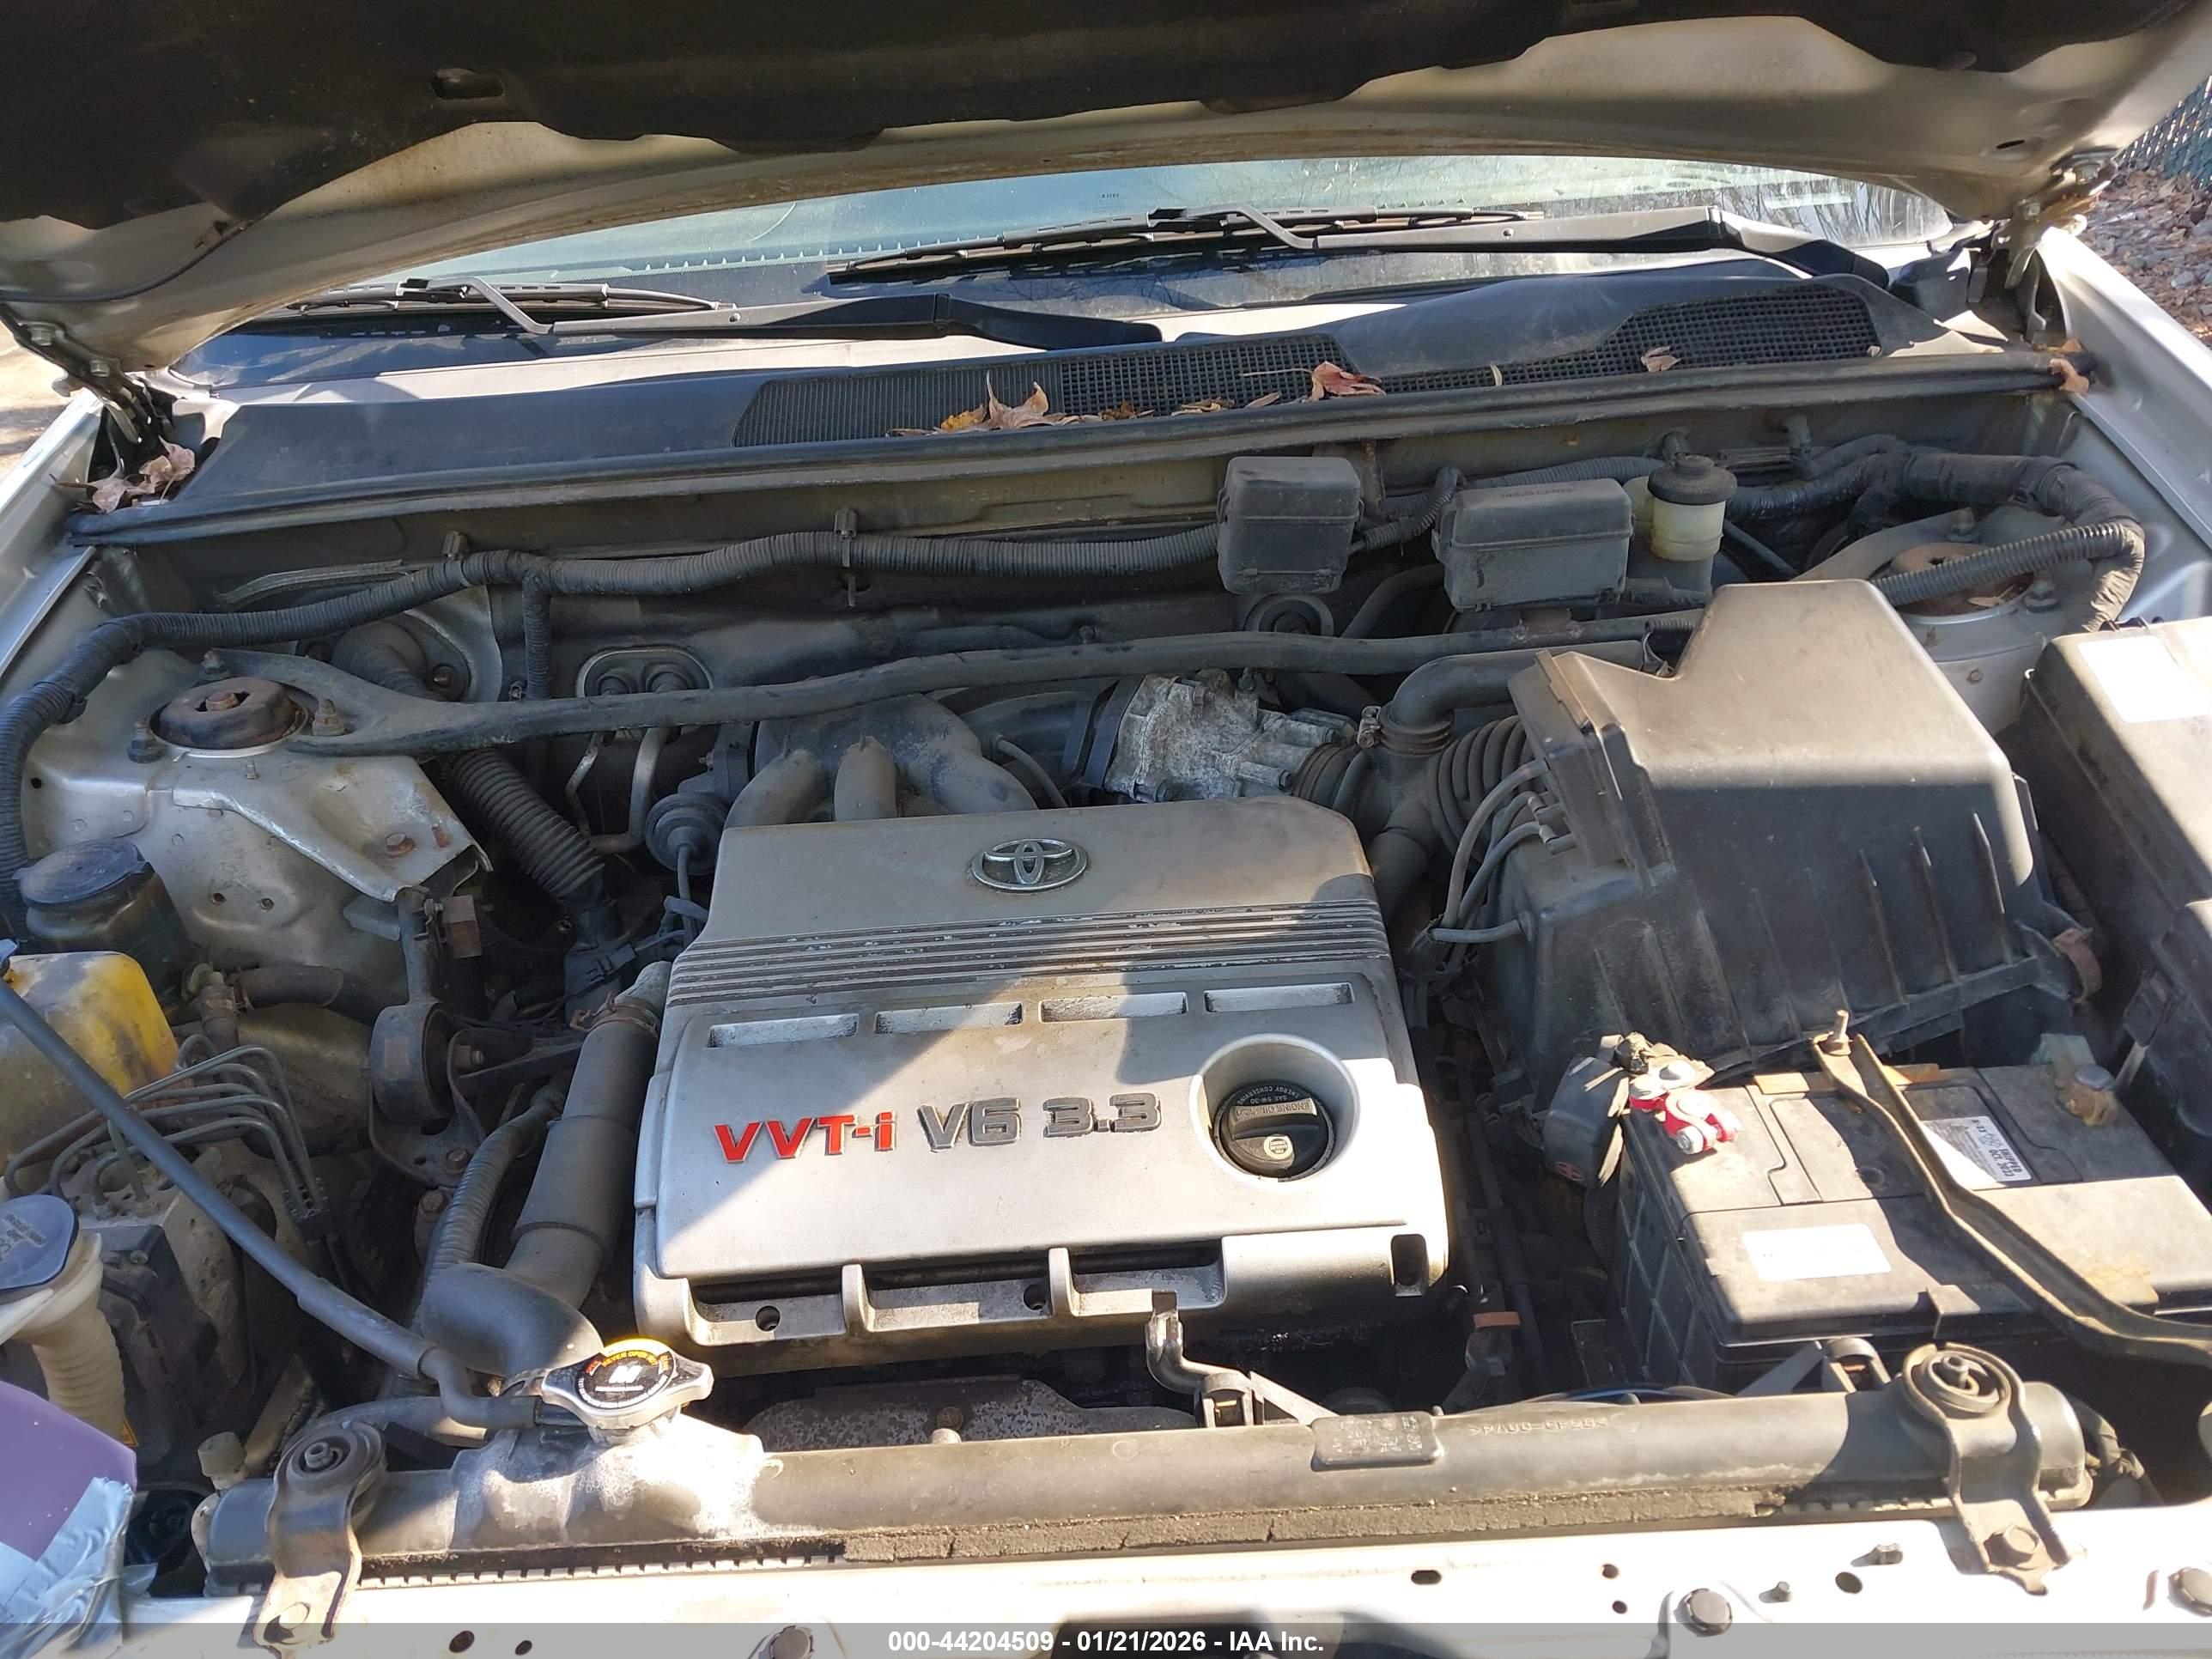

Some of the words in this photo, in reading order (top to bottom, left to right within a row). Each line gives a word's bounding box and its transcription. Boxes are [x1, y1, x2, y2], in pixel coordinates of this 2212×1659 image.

[1237, 1085, 1273, 1105] CONSERVING
[1275, 1086, 1300, 1099] ENERGY
[1249, 1096, 1271, 1105] 5W-30
[1277, 1102, 1310, 1111] ENGINE
[714, 1110, 897, 1164] VVT-i
[915, 1097, 1022, 1153] V6
[1042, 1092, 1162, 1138] 3.3
[1999, 1148, 2022, 1173] SHIPPED
[1996, 1162, 2014, 1177] 2023
